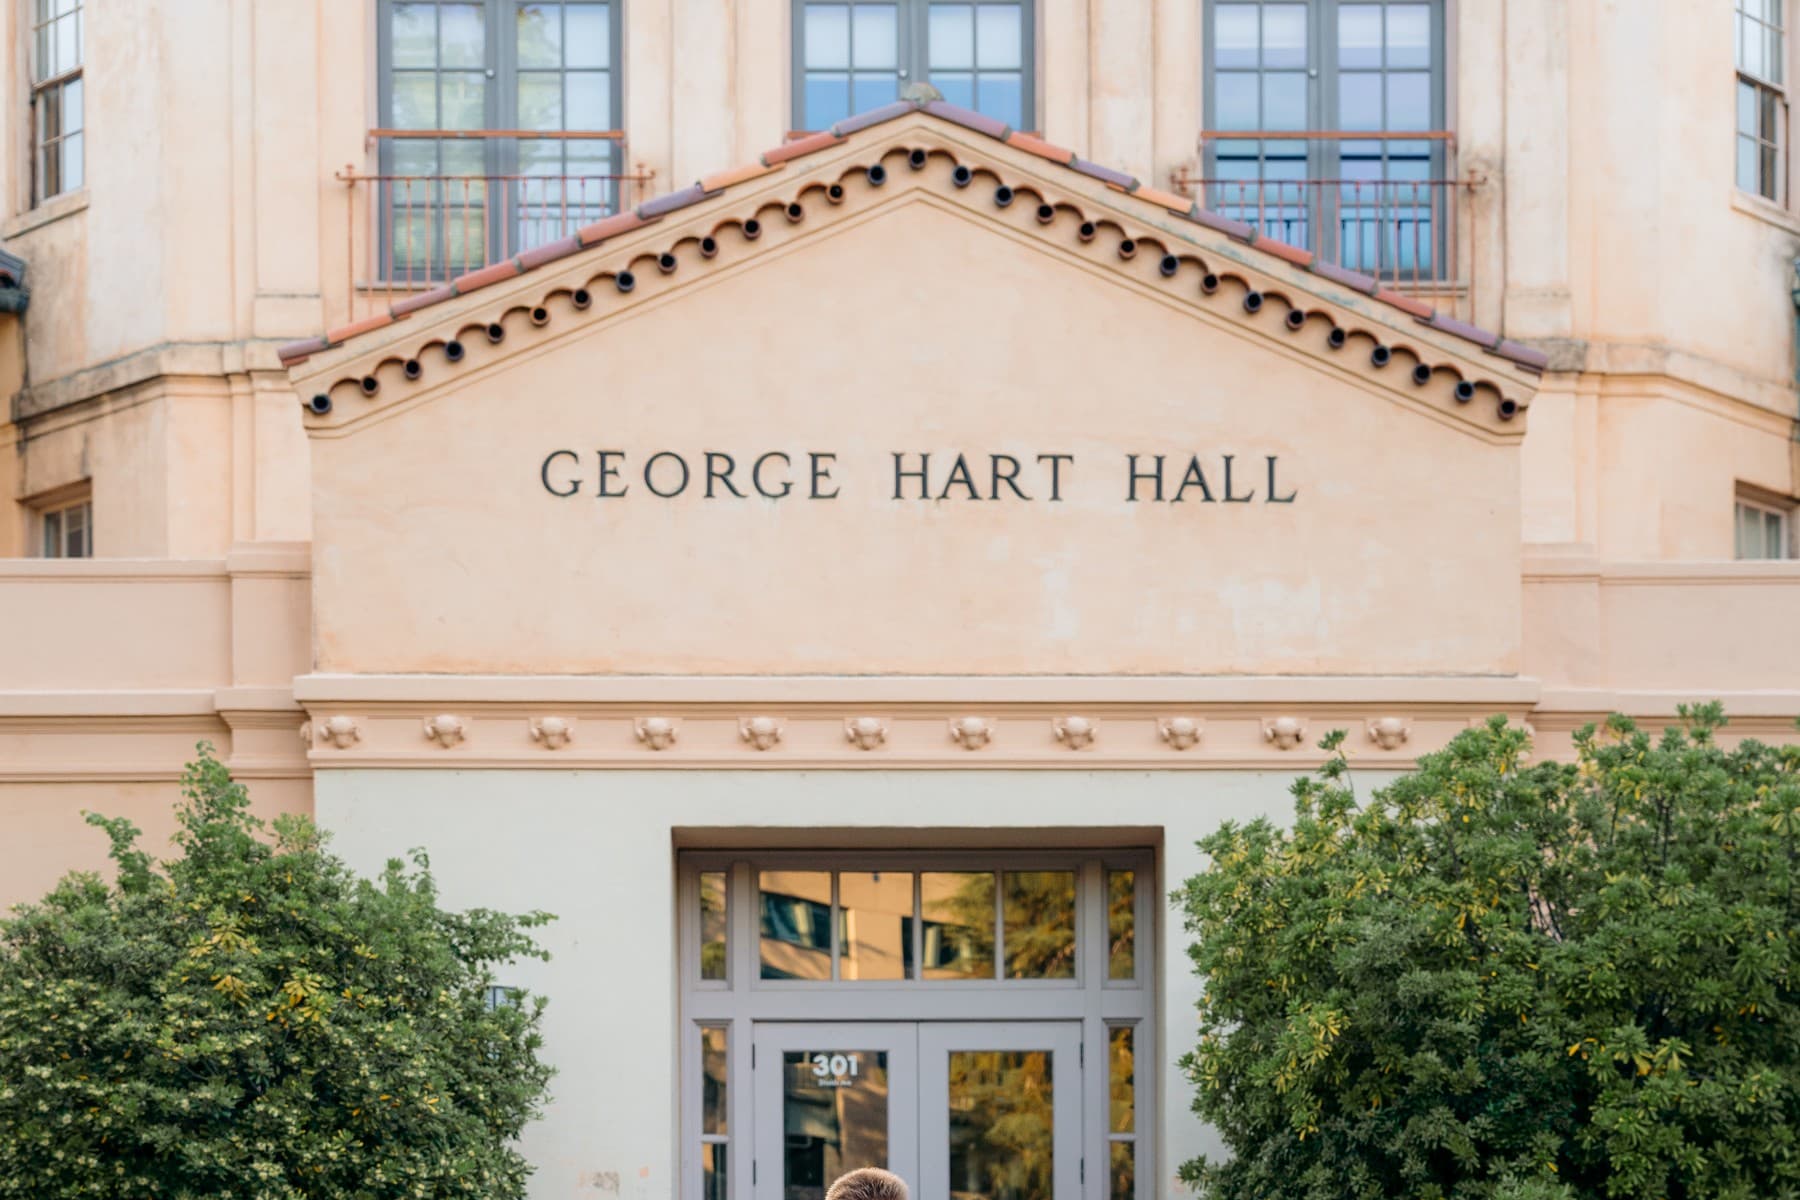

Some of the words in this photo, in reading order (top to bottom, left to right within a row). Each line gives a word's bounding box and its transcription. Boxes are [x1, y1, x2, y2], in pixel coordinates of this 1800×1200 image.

[540, 449, 840, 500] GEORGE
[891, 452, 1074, 502] HART
[1125, 453, 1298, 504] HALL
[813, 1054, 858, 1077] 301
